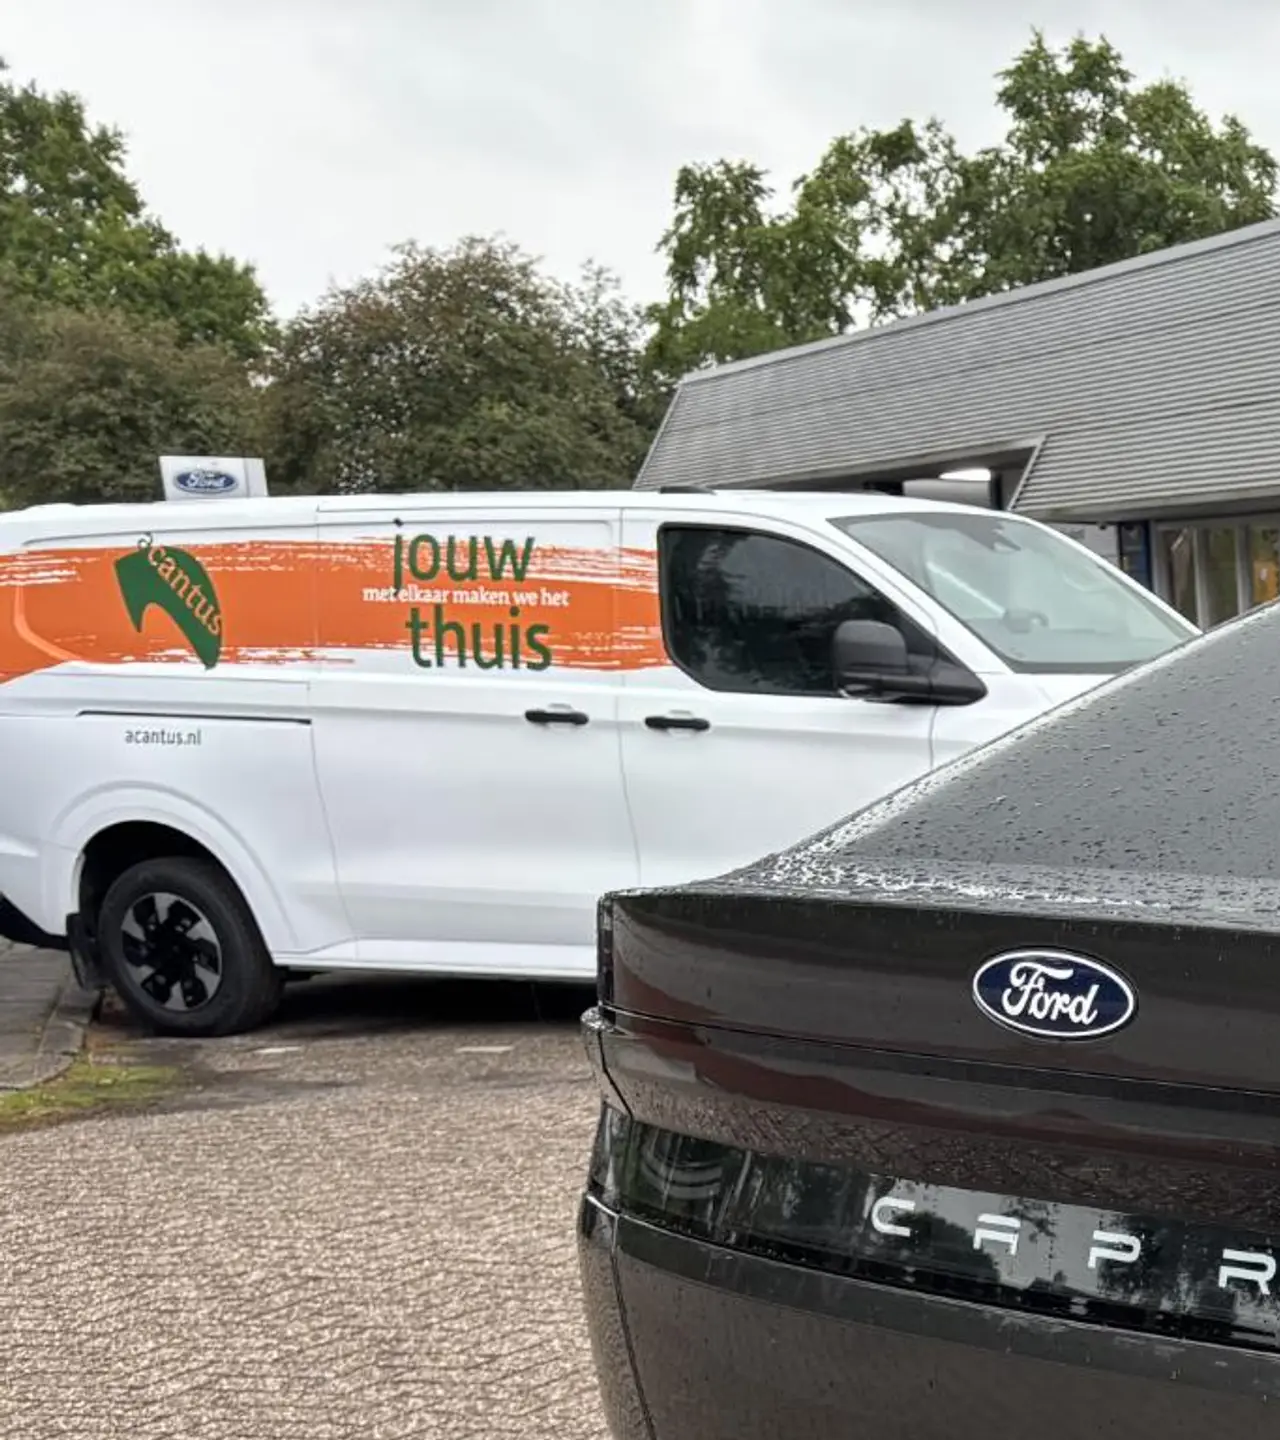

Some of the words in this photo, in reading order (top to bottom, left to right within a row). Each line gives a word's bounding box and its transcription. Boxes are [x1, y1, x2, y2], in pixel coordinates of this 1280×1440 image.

[393, 517, 535, 596] jouw
[362, 587, 397, 602] met
[398, 584, 449, 604] elkaar
[452, 585, 511, 605] maken
[513, 591, 538, 606] we
[540, 587, 571, 607] het
[405, 603, 551, 671] thuis
[125, 728, 202, 746] acantus.nl
[1000, 960, 1099, 1026] Ford
